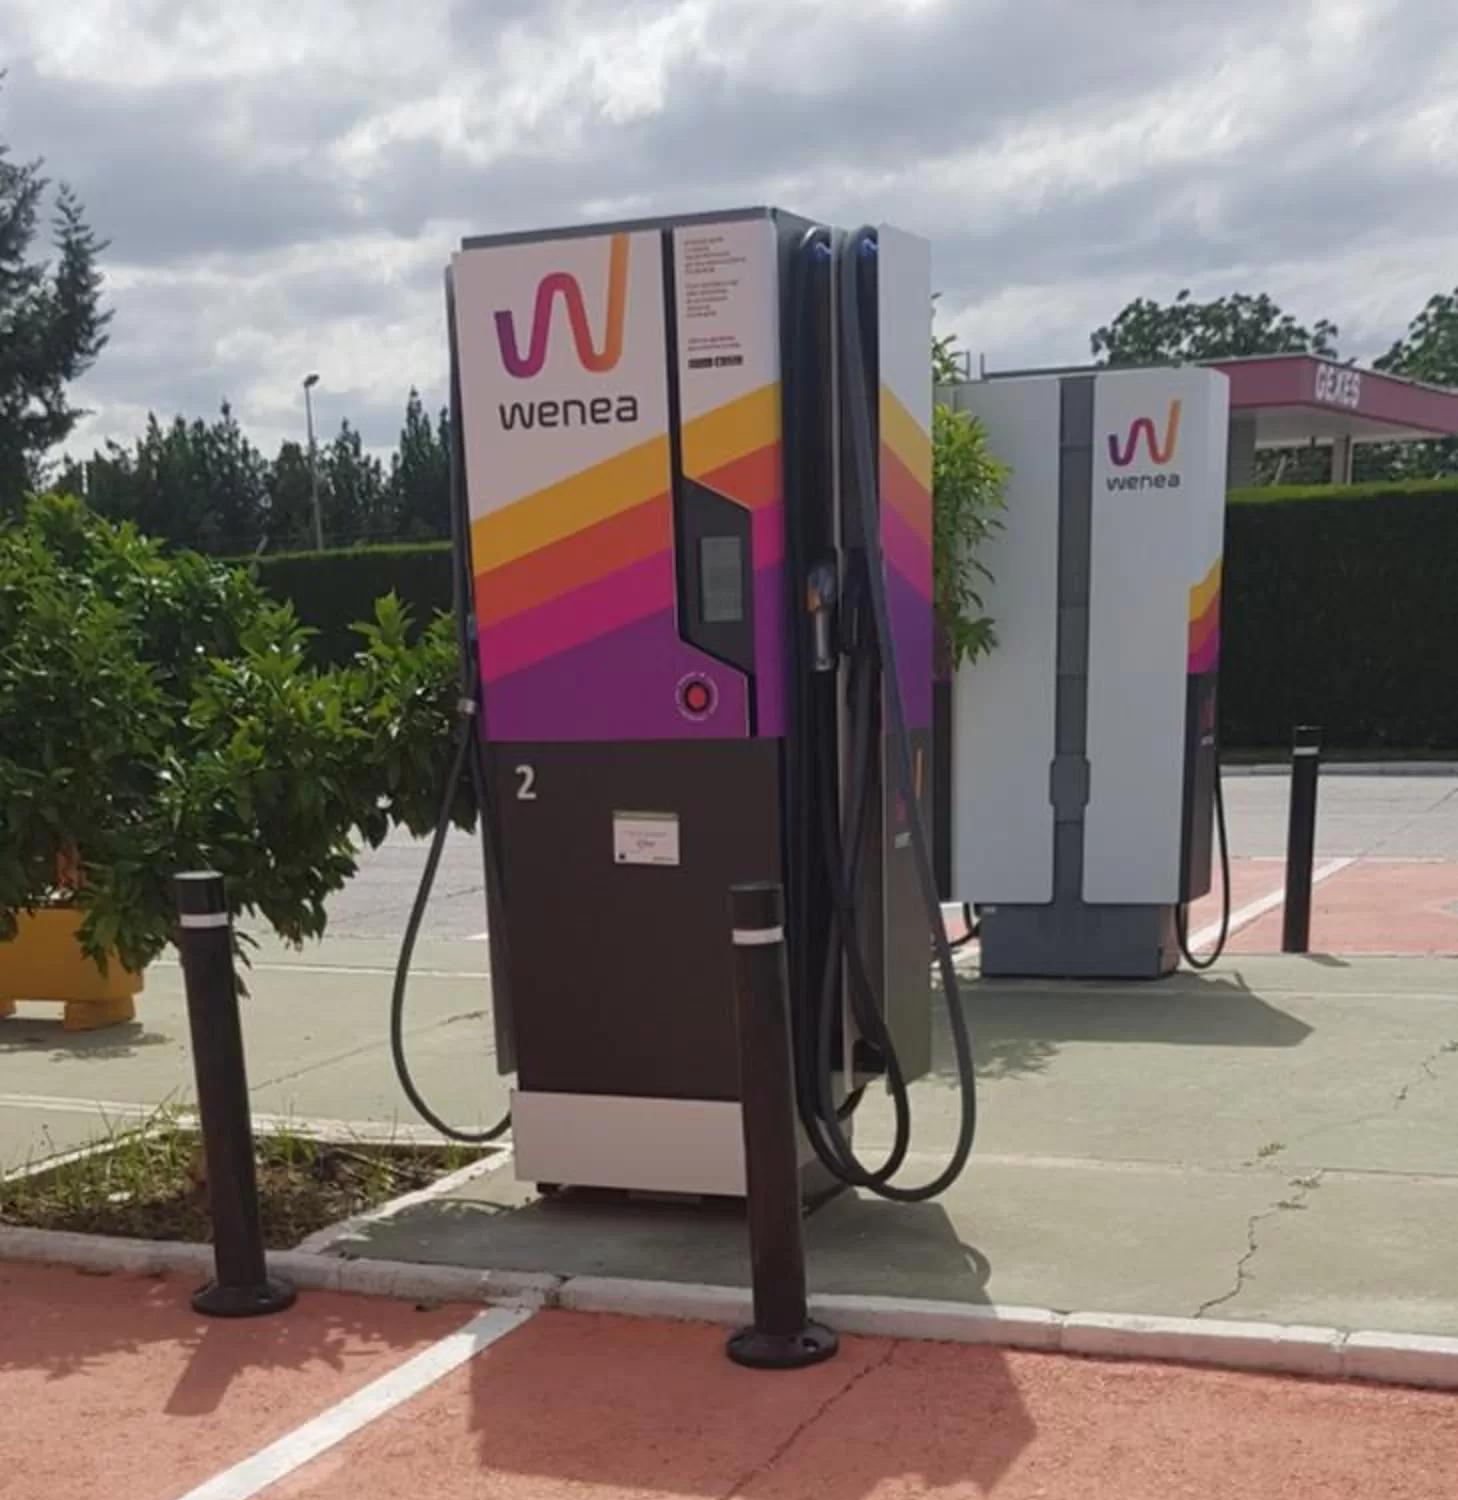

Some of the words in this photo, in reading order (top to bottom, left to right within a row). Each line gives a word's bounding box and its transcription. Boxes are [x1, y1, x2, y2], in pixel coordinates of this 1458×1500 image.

[499, 396, 638, 430] wenea
[1106, 473, 1181, 491] wenea
[515, 764, 537, 800] 2
